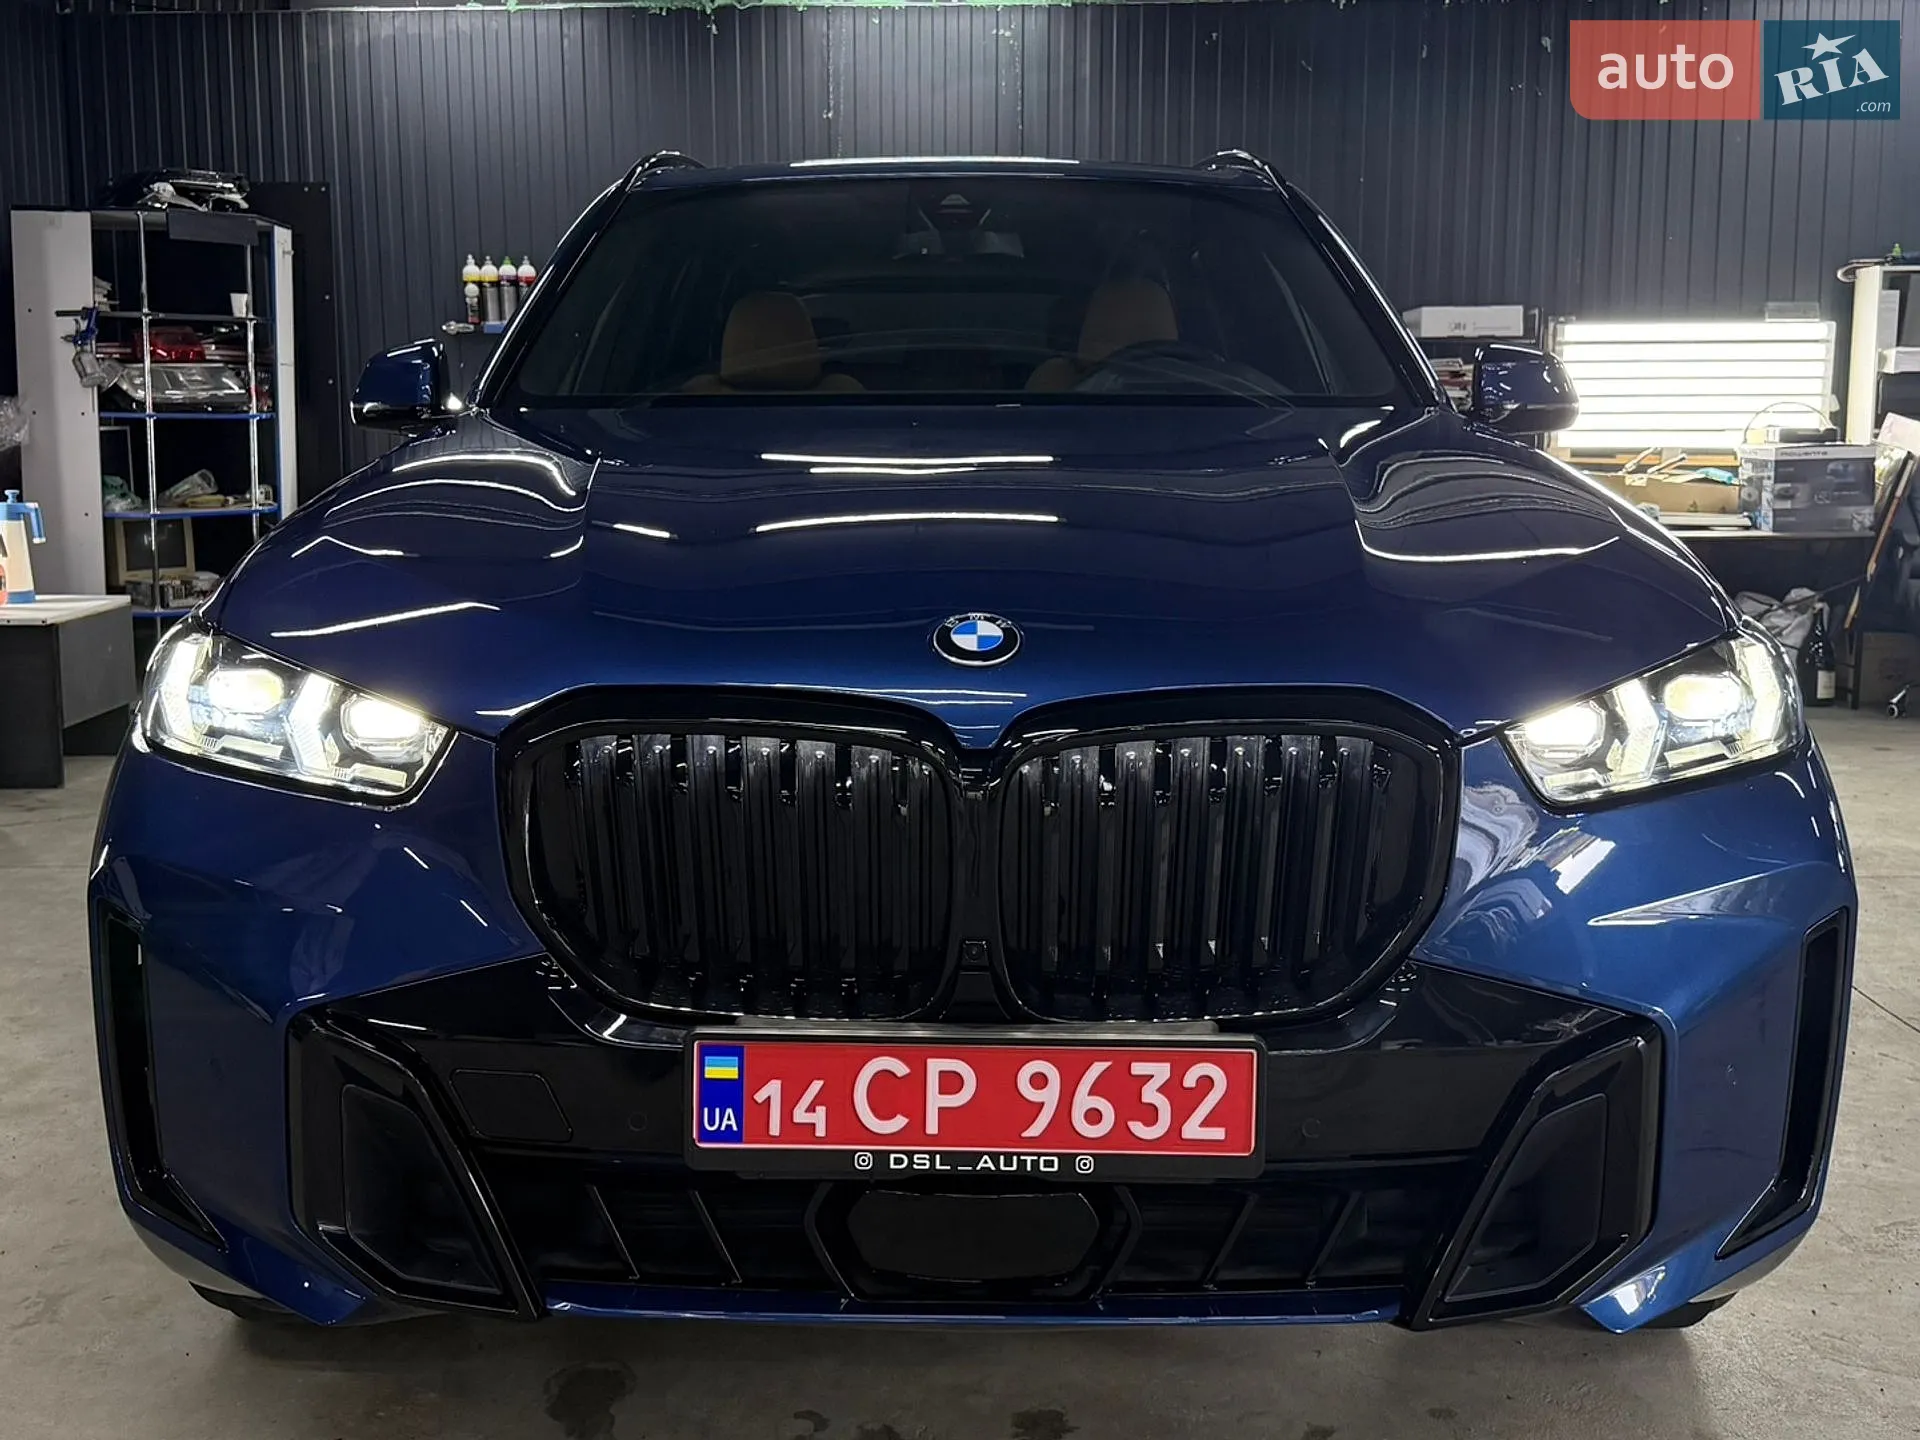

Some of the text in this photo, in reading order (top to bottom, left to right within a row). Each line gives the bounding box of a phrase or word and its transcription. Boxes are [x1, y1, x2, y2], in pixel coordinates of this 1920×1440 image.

[753, 1056, 1227, 1140] 14 CP 9632
[703, 1107, 738, 1132] UA
[889, 1154, 1059, 1172] DSL_AUTO
